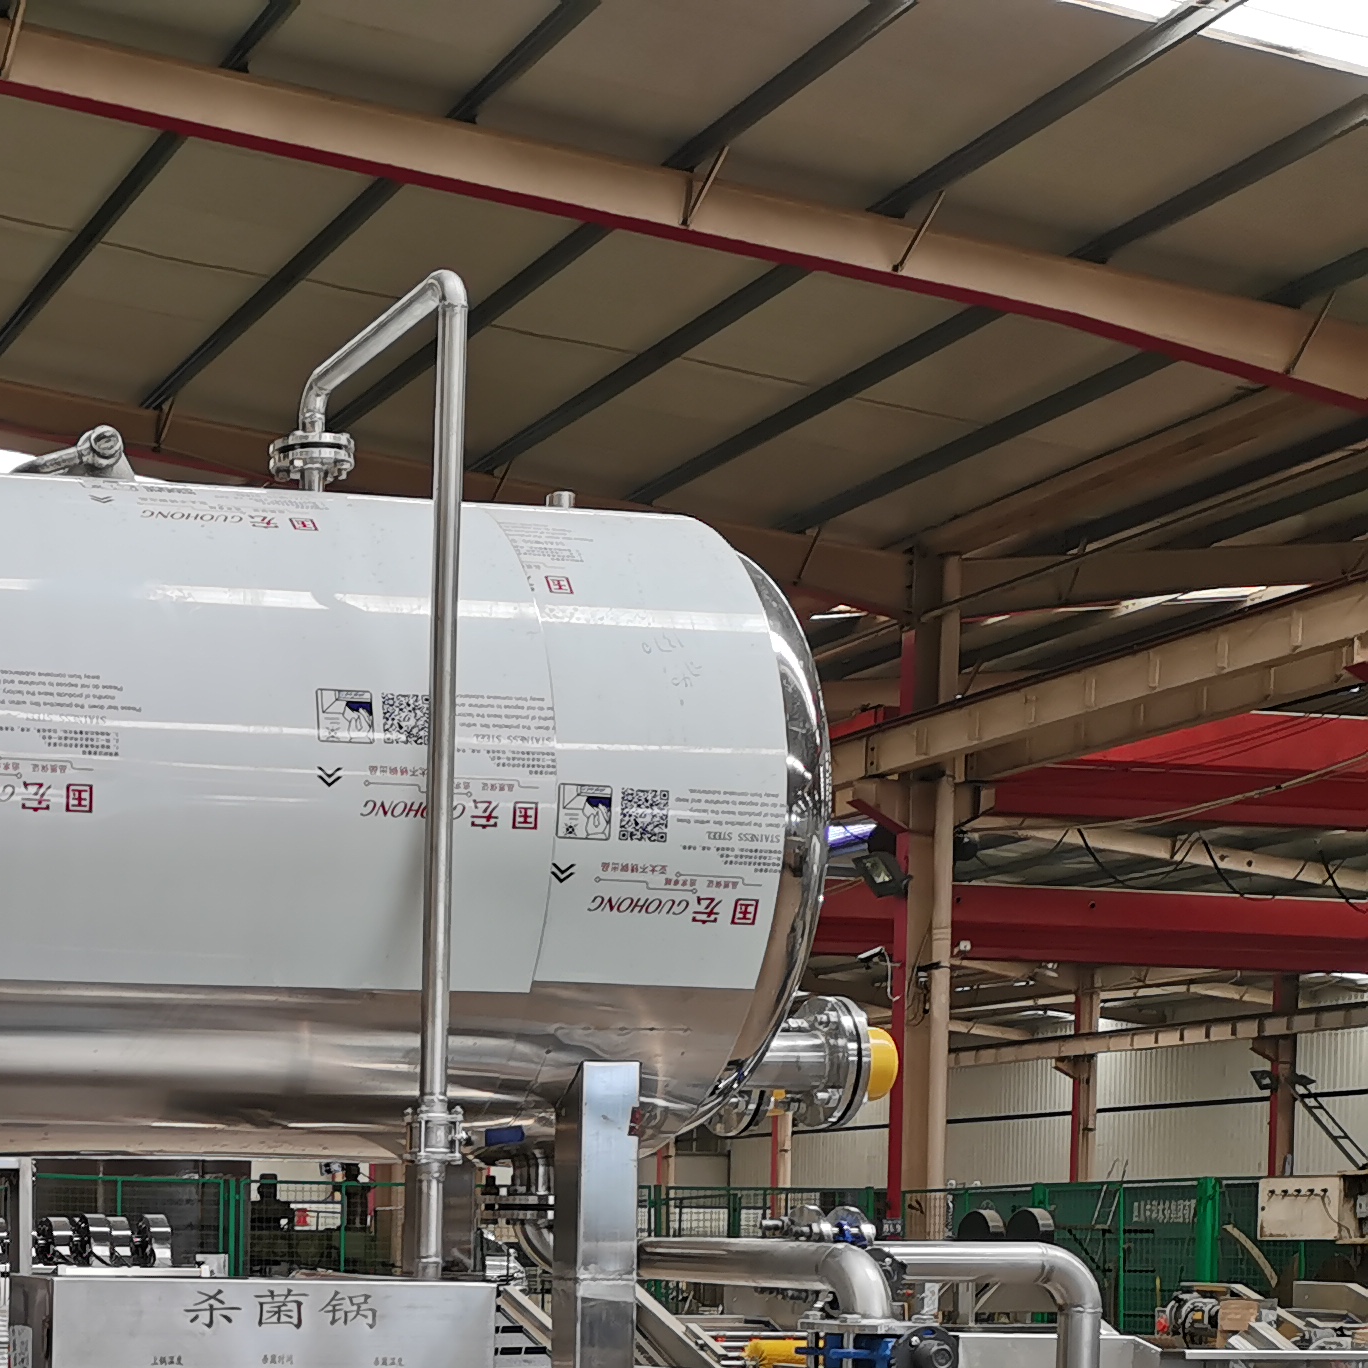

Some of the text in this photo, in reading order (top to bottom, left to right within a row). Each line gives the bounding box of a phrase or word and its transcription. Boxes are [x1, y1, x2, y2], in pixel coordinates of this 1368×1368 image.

[140, 509, 243, 524] GUOHONG
[369, 765, 428, 777] 太不锈钢出品
[22, 781, 93, 813] 国宏
[471, 799, 538, 830] 国宏
[587, 896, 760, 926] 国宏 GUOHONG
[183, 1287, 379, 1330] 杀菌锅
